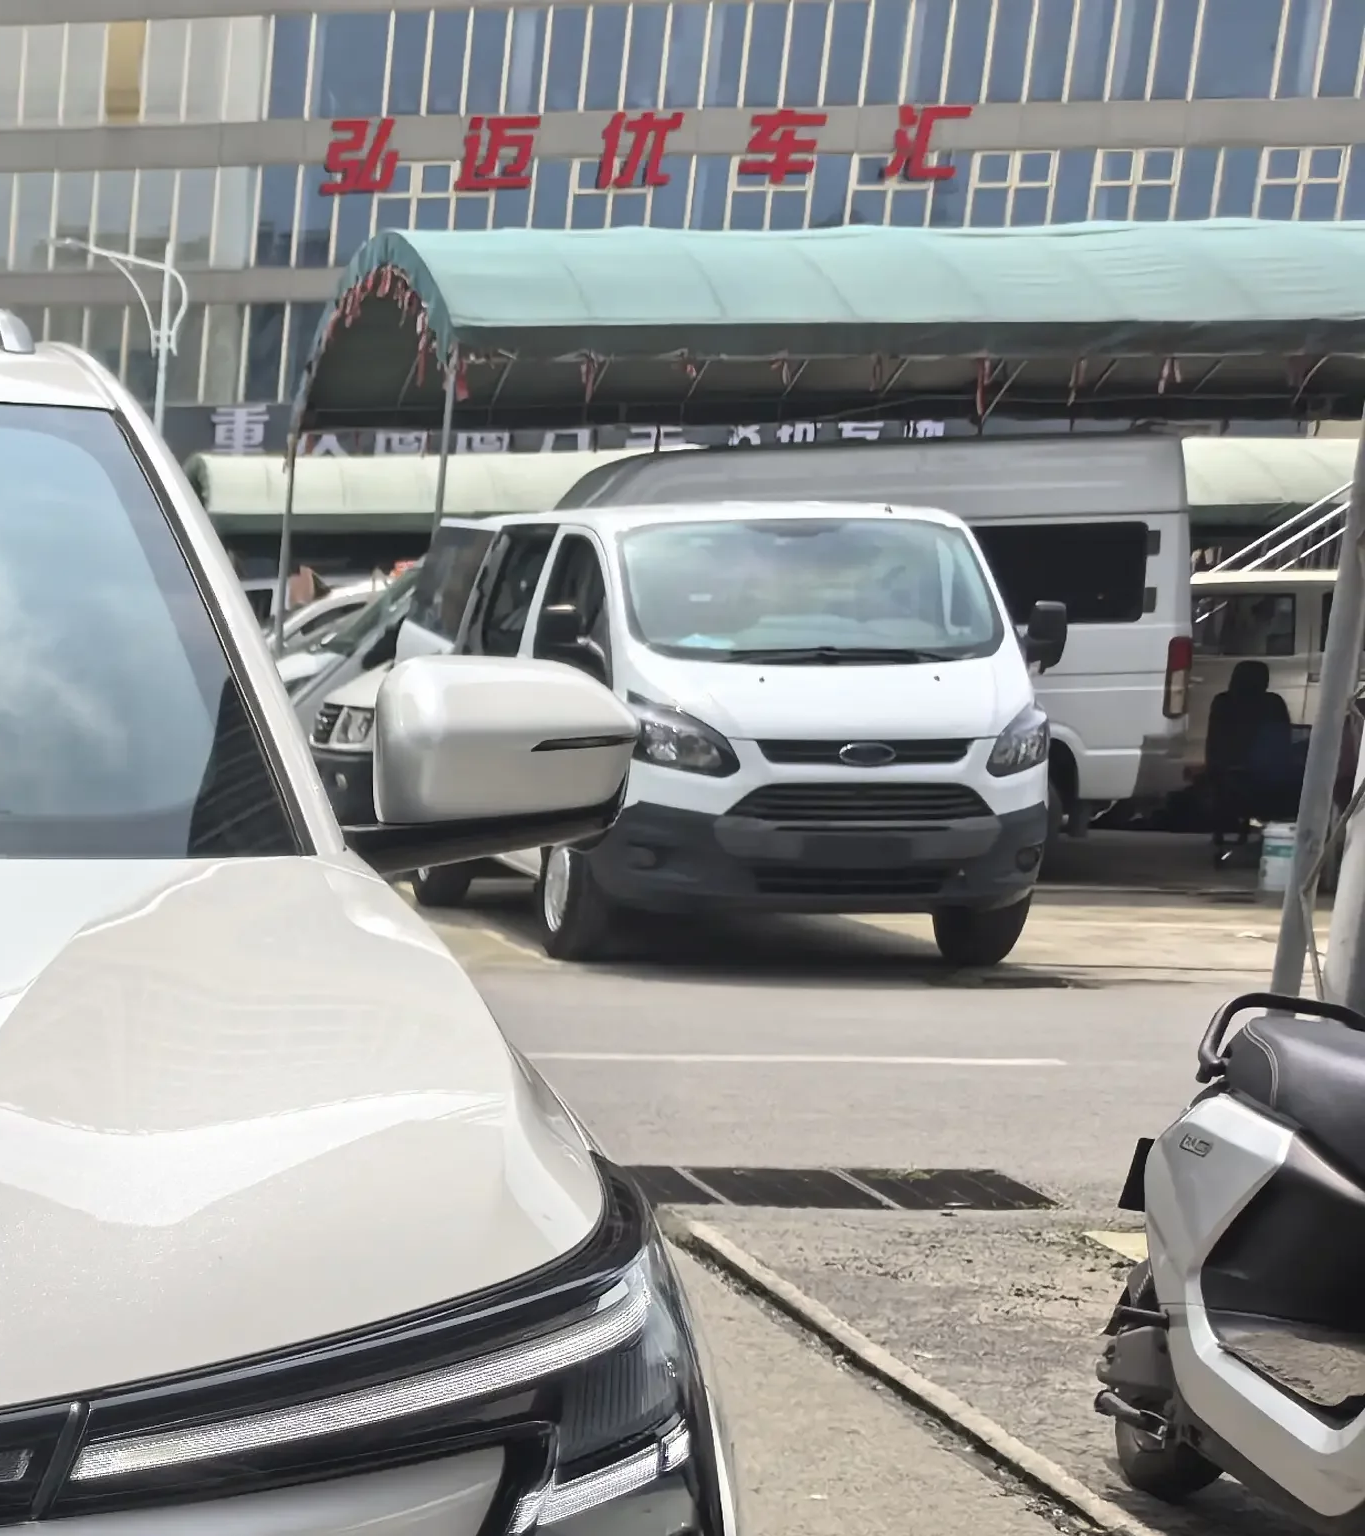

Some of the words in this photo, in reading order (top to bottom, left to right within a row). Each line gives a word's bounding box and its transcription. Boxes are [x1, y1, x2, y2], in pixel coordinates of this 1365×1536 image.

[321, 105, 972, 195] 弘迈优车汇
